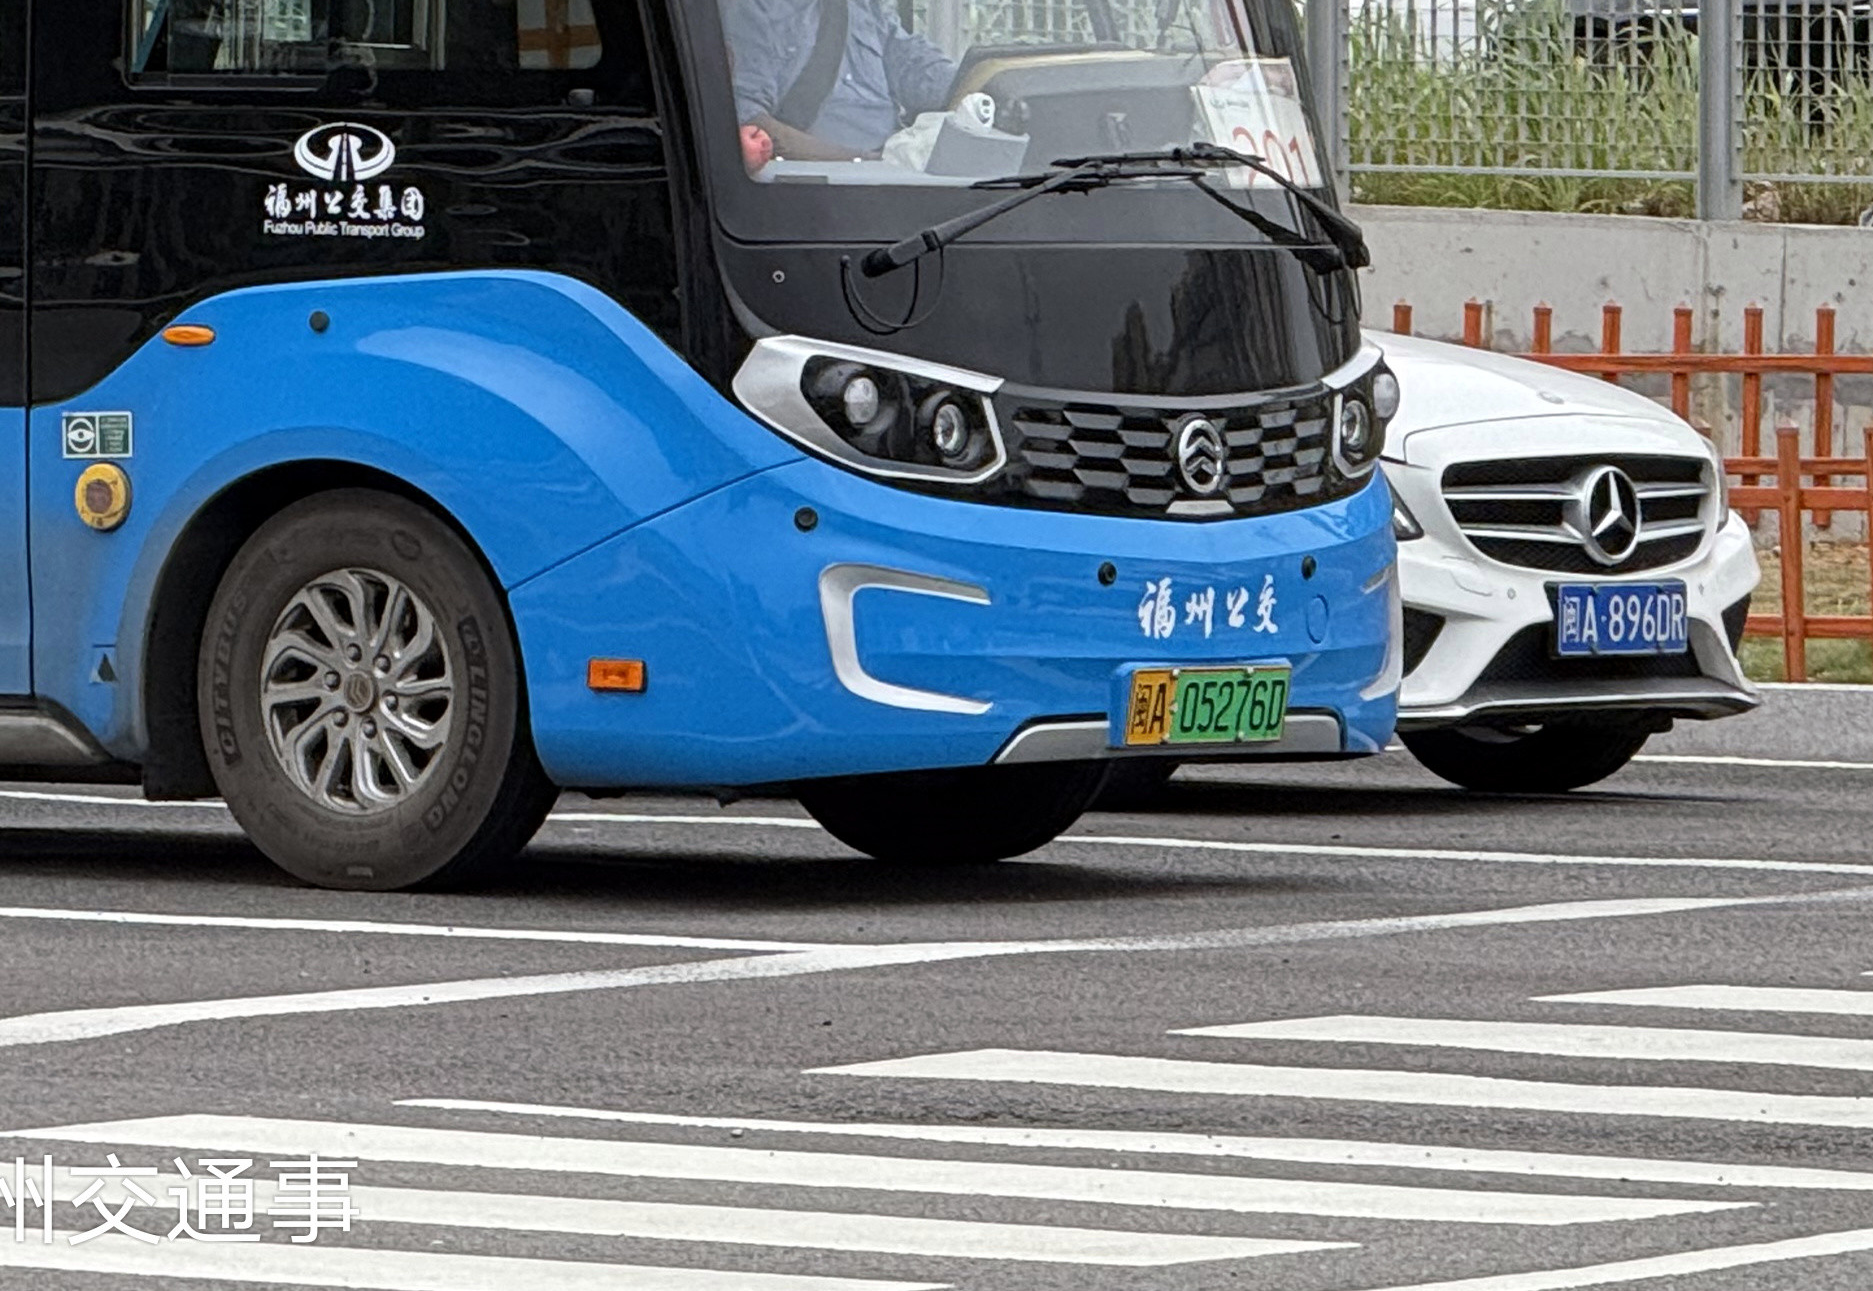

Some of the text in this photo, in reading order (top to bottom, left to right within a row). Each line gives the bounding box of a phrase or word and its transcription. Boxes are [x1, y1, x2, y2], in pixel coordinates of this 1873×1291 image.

[264, 182, 425, 221] 福州公交集团
[263, 220, 426, 239] Fuzhou Public Transport Group
[1138, 573, 1278, 639] 福州公交
